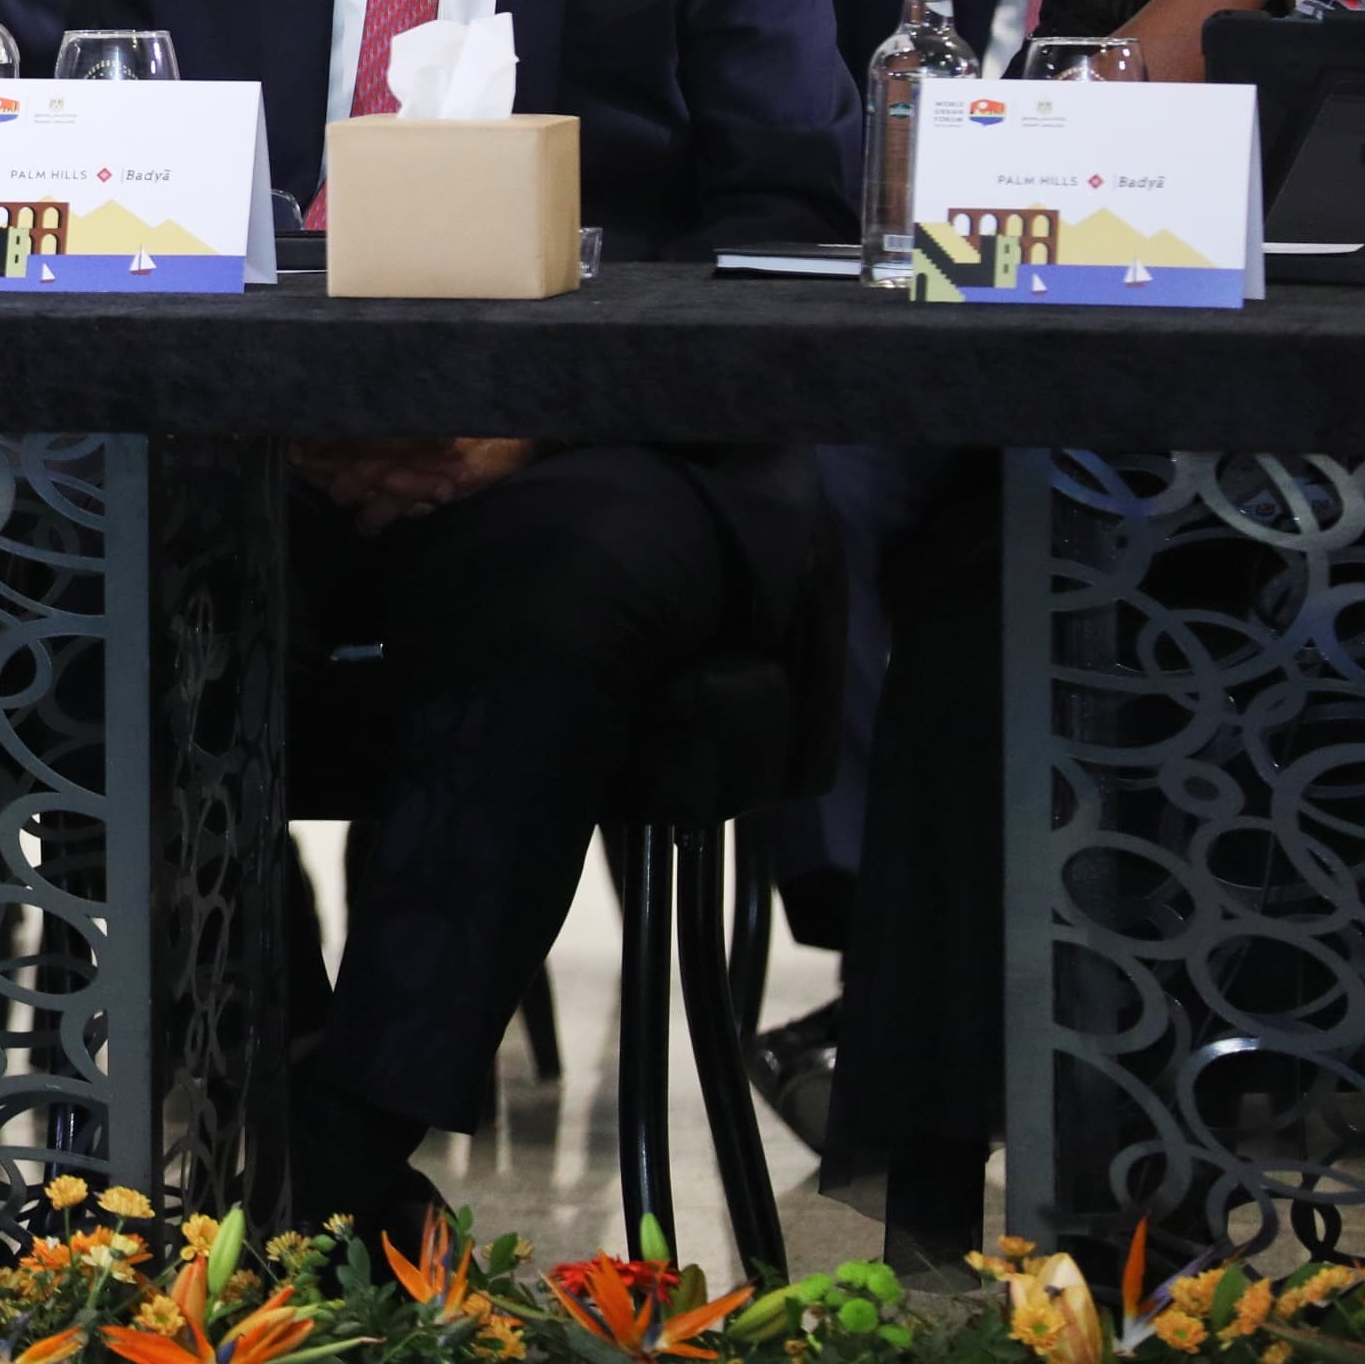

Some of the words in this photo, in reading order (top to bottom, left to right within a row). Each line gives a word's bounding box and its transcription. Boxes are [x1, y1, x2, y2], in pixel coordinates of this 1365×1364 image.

[10, 170, 46, 180] PALM
[51, 170, 87, 180] HILLS
[998, 175, 1035, 186] PALM
[1041, 176, 1078, 186] HILLS
